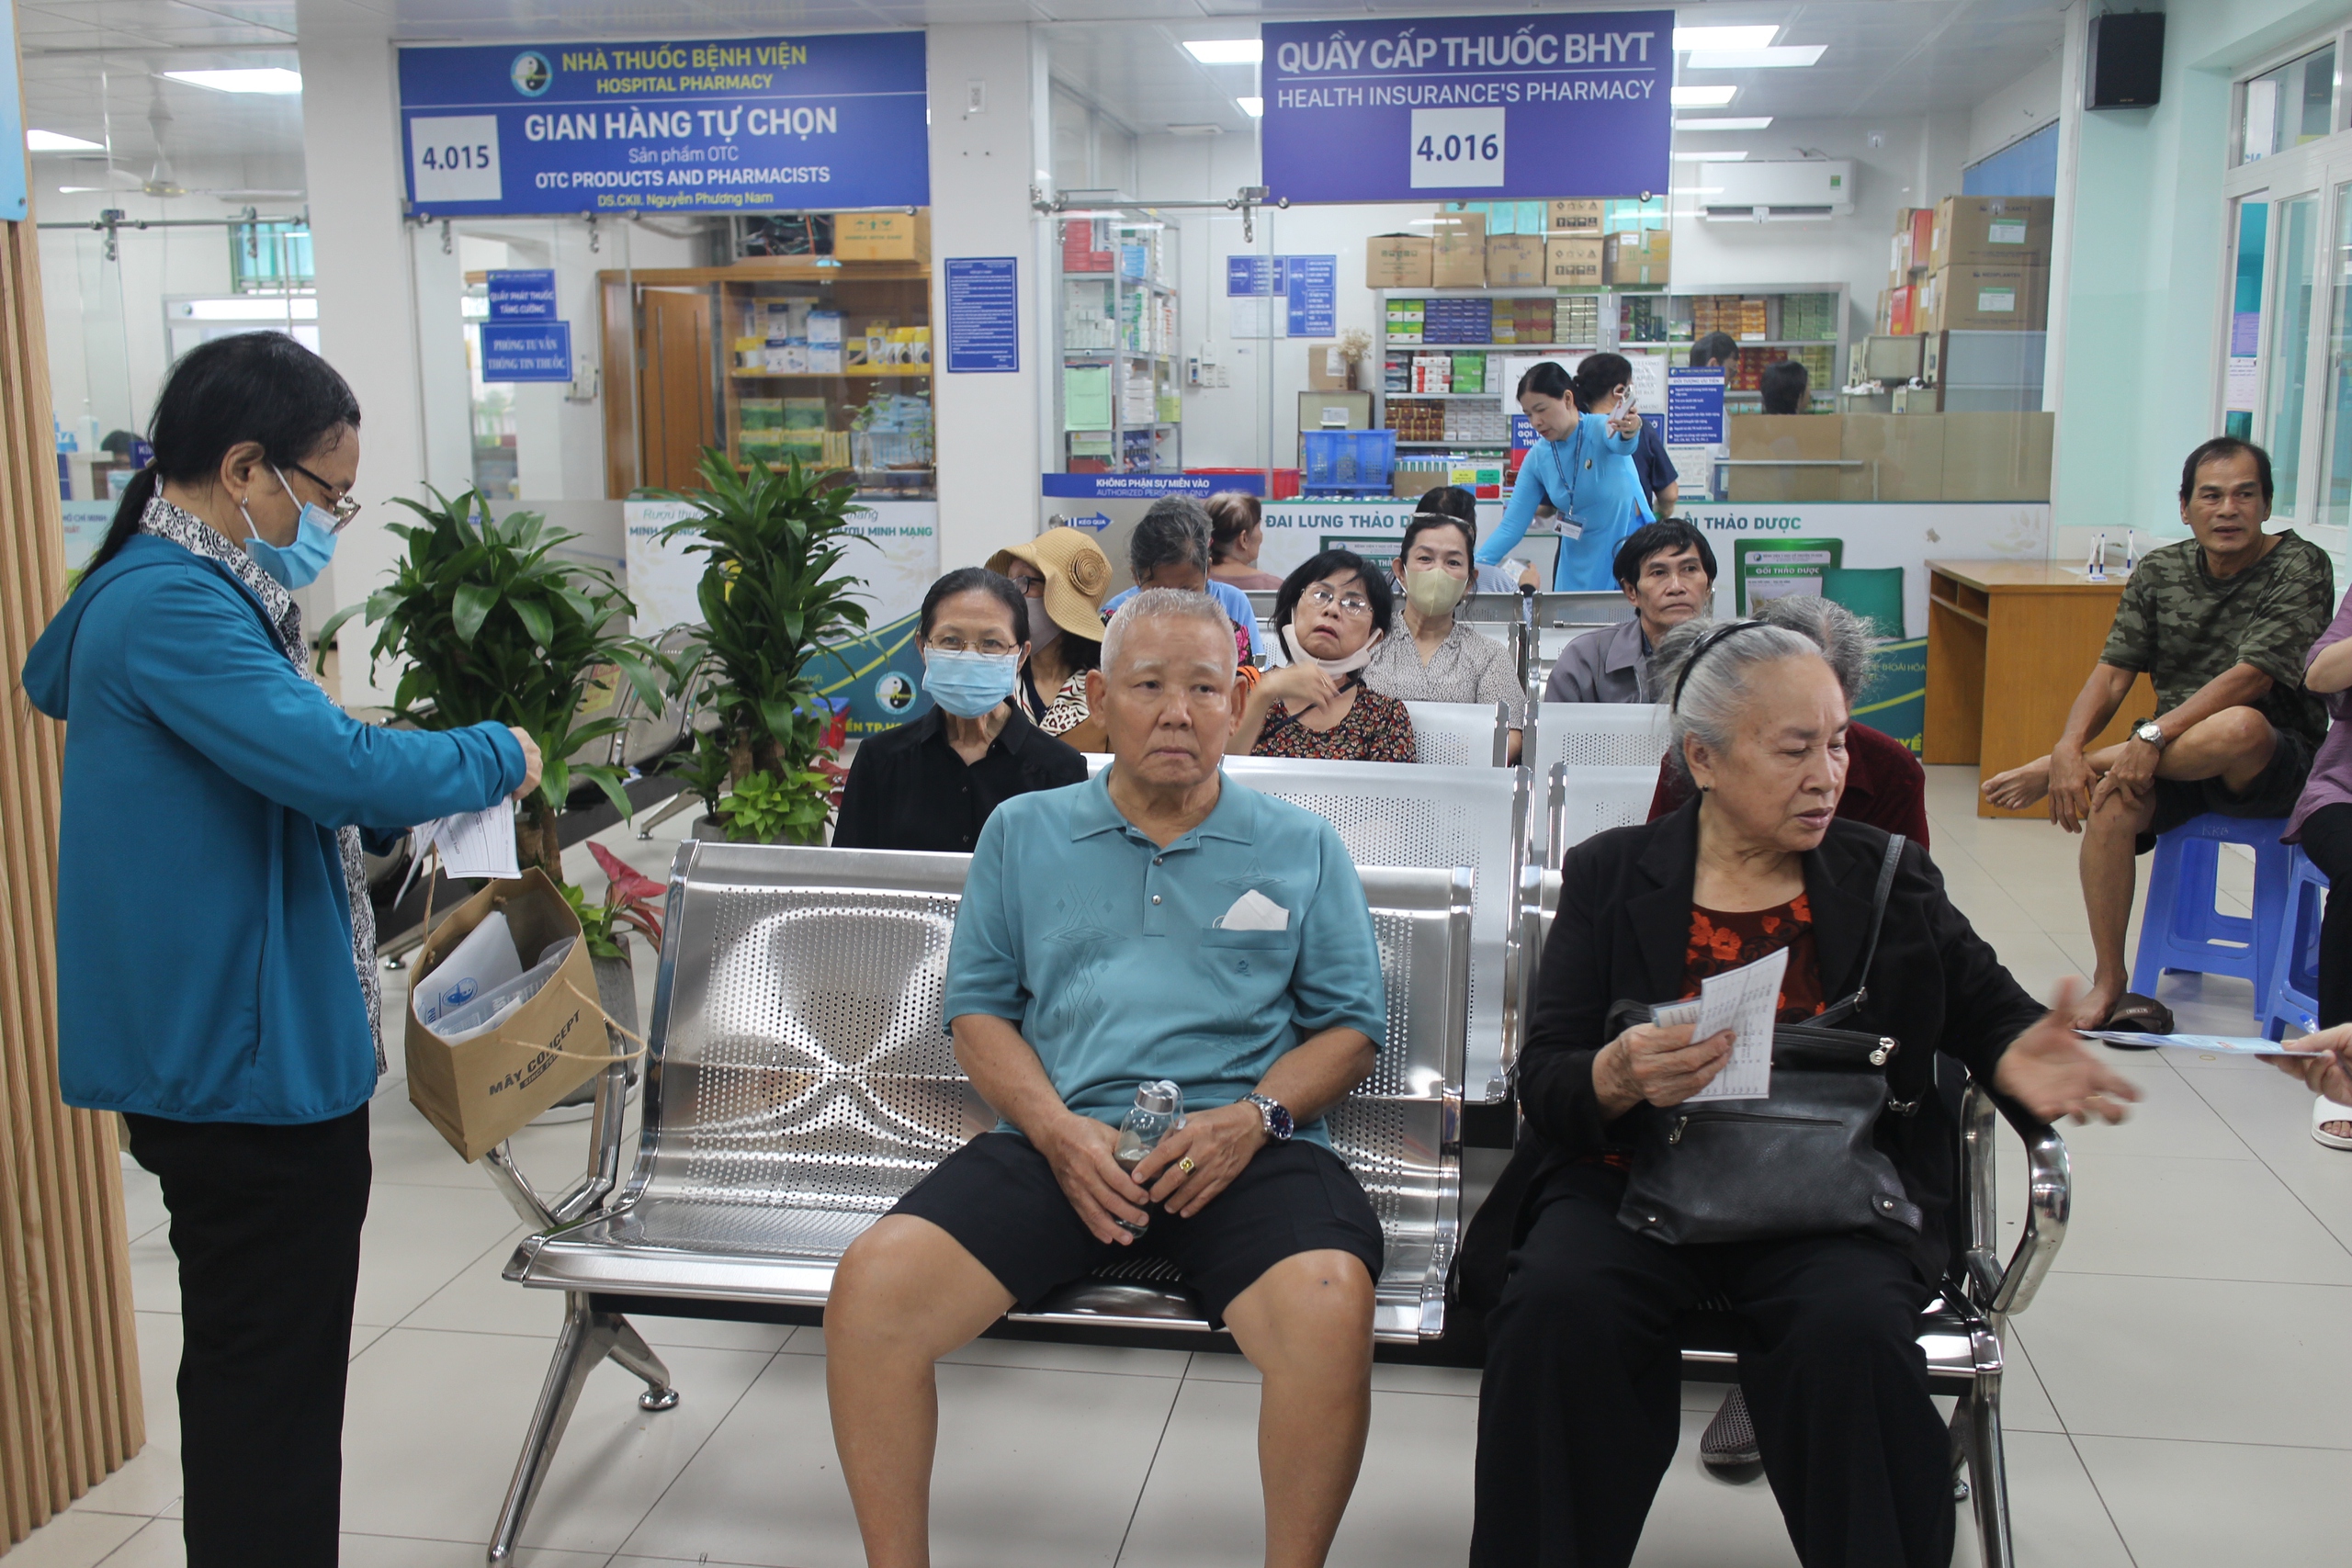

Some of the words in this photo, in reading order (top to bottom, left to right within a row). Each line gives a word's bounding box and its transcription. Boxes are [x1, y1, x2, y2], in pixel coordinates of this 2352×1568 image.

[562, 48, 608, 72] NHÀ
[611, 42, 687, 70] THUỐC
[692, 43, 751, 72] BỆNH
[756, 41, 807, 70] VIỆN
[1277, 29, 1366, 73] QUẦY
[1370, 28, 1438, 69] CẤP
[1441, 24, 1558, 67] THUỐC
[1565, 31, 1655, 63] BHYT
[597, 77, 676, 93] HOSPITAL
[680, 73, 774, 91] PHARMACY
[1278, 87, 1363, 108] HEALTH
[1370, 82, 1521, 106] INSURANCE'S
[1526, 79, 1655, 102] PHARMACY
[524, 113, 596, 141] GIAN
[605, 106, 692, 139] HÀNG
[697, 106, 742, 143] TỰ
[747, 107, 837, 141] CHỌN
[422, 145, 490, 171] 4.015
[628, 146, 658, 164] Sản
[707, 145, 739, 162] OTC
[1417, 134, 1499, 161] 4.016
[536, 172, 569, 188] OTC
[571, 170, 663, 187] PRODUCTS
[667, 169, 704, 186] AND
[707, 166, 831, 185] PHARMACISTS
[745, 191, 774, 204] Nam
[1096, 477, 1126, 488] KHÔNG
[1128, 477, 1153, 490] PHẬN
[1154, 479, 1168, 490] SỰ
[1192, 477, 1210, 488] VÀO
[1096, 489, 1143, 497] AUTHORIZED
[1265, 515, 1293, 528] ĐAI
[1298, 513, 1343, 528] LƯNG
[1349, 511, 1394, 528] THẢO
[1704, 513, 1747, 530] THẢO
[1754, 516, 1802, 534] DƯỢC
[629, 526, 659, 536] MINH
[868, 526, 896, 536] MINH
[899, 526, 933, 539] MẠNG
[489, 1068, 523, 1096] MÂY
